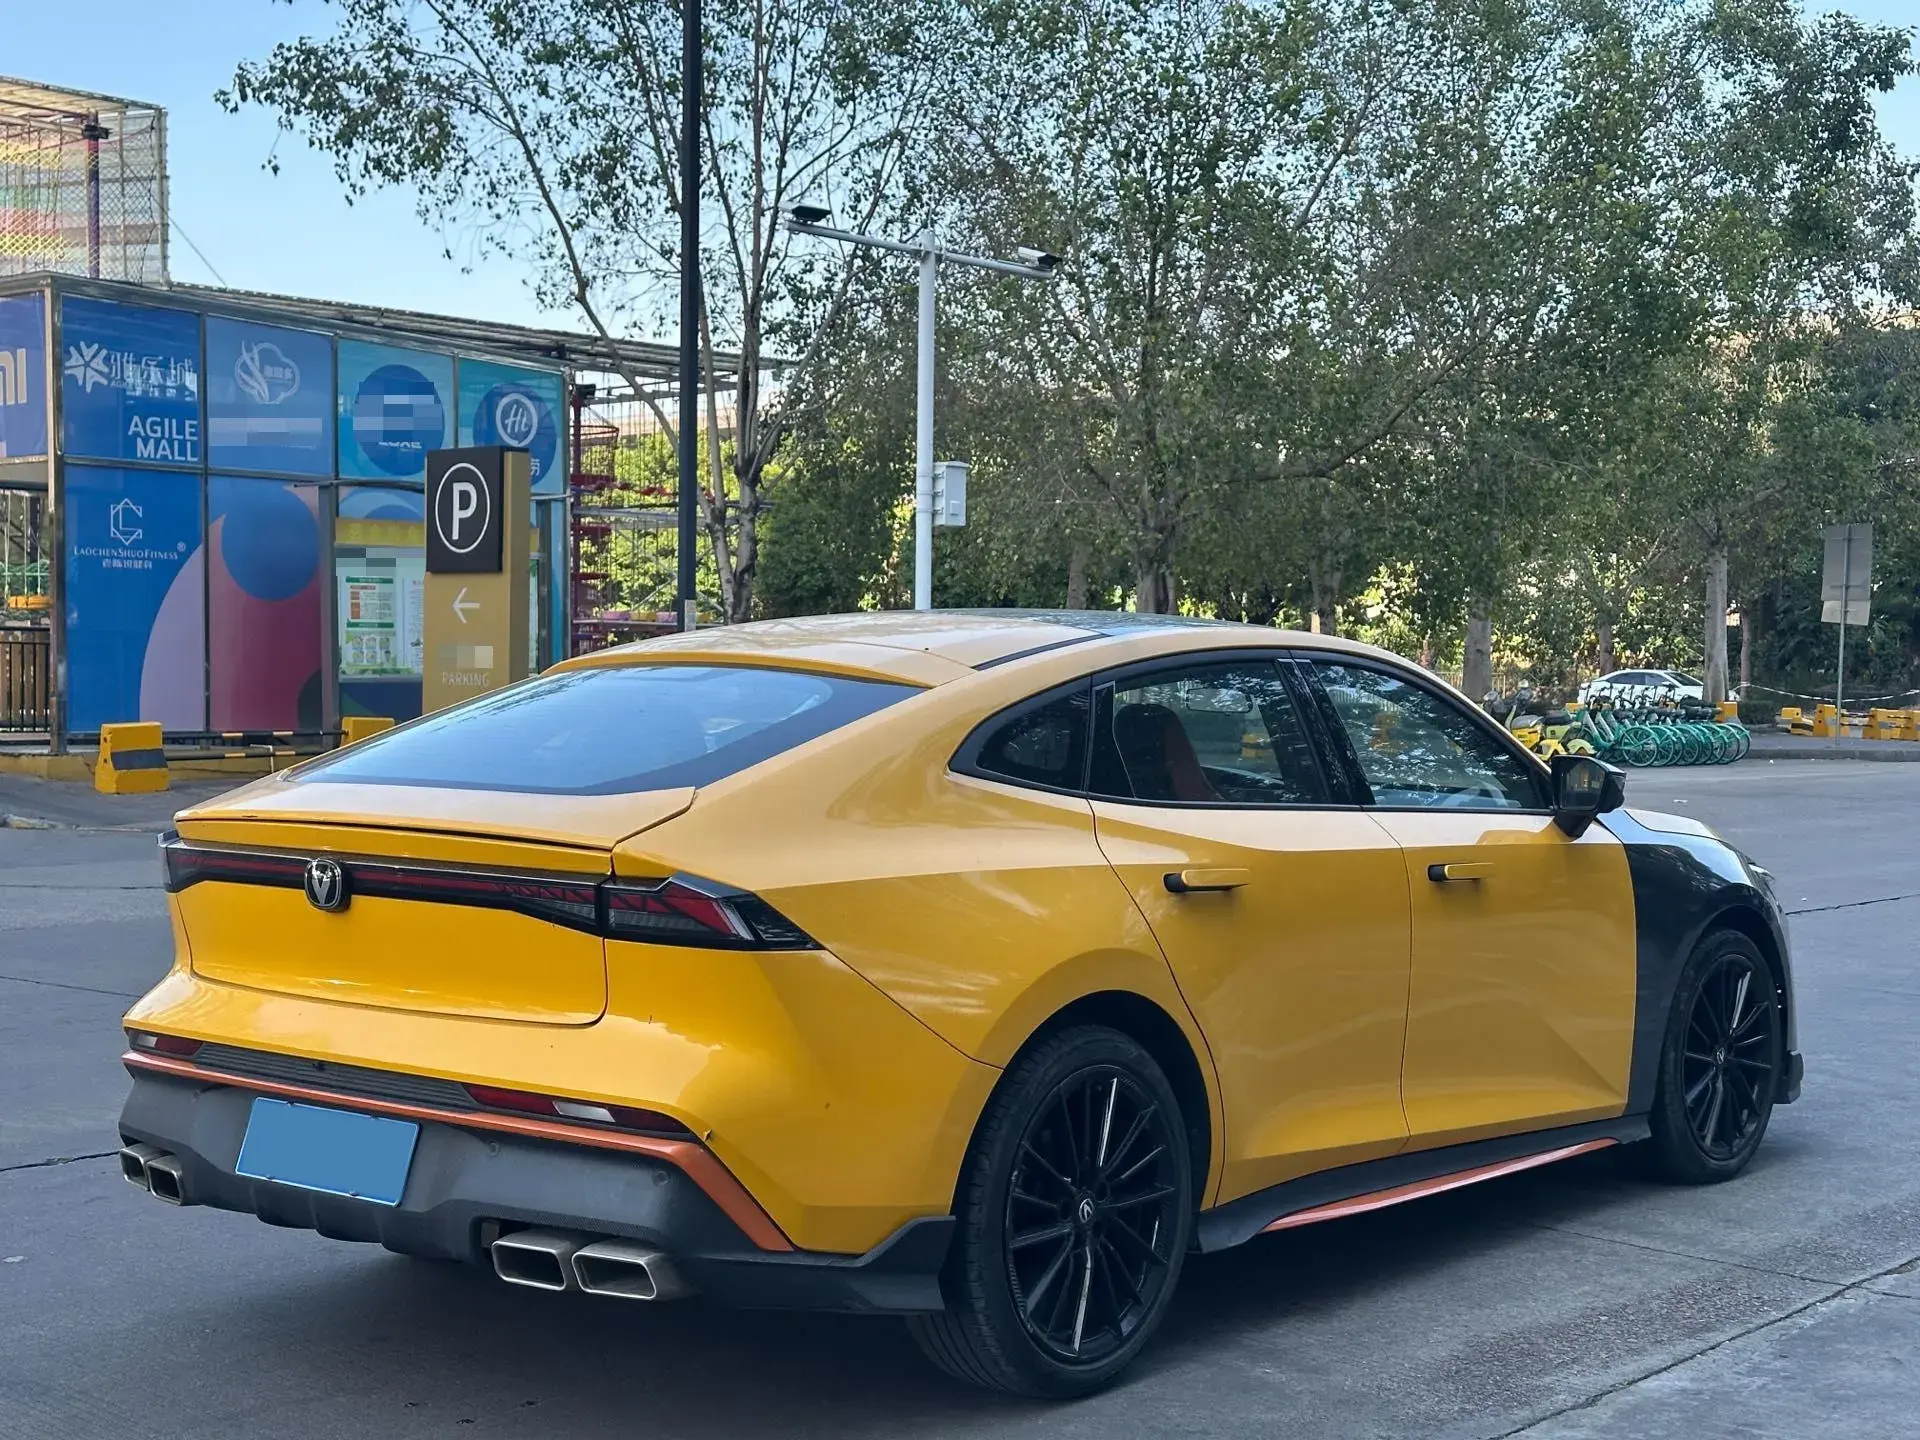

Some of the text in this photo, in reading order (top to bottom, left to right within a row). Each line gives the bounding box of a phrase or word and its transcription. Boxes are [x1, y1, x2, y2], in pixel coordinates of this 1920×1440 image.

[128, 415, 199, 441] AGILE
[504, 403, 530, 434] Hi
[136, 437, 199, 462] MALL
[451, 481, 478, 541] P
[442, 671, 490, 687] PARKING
